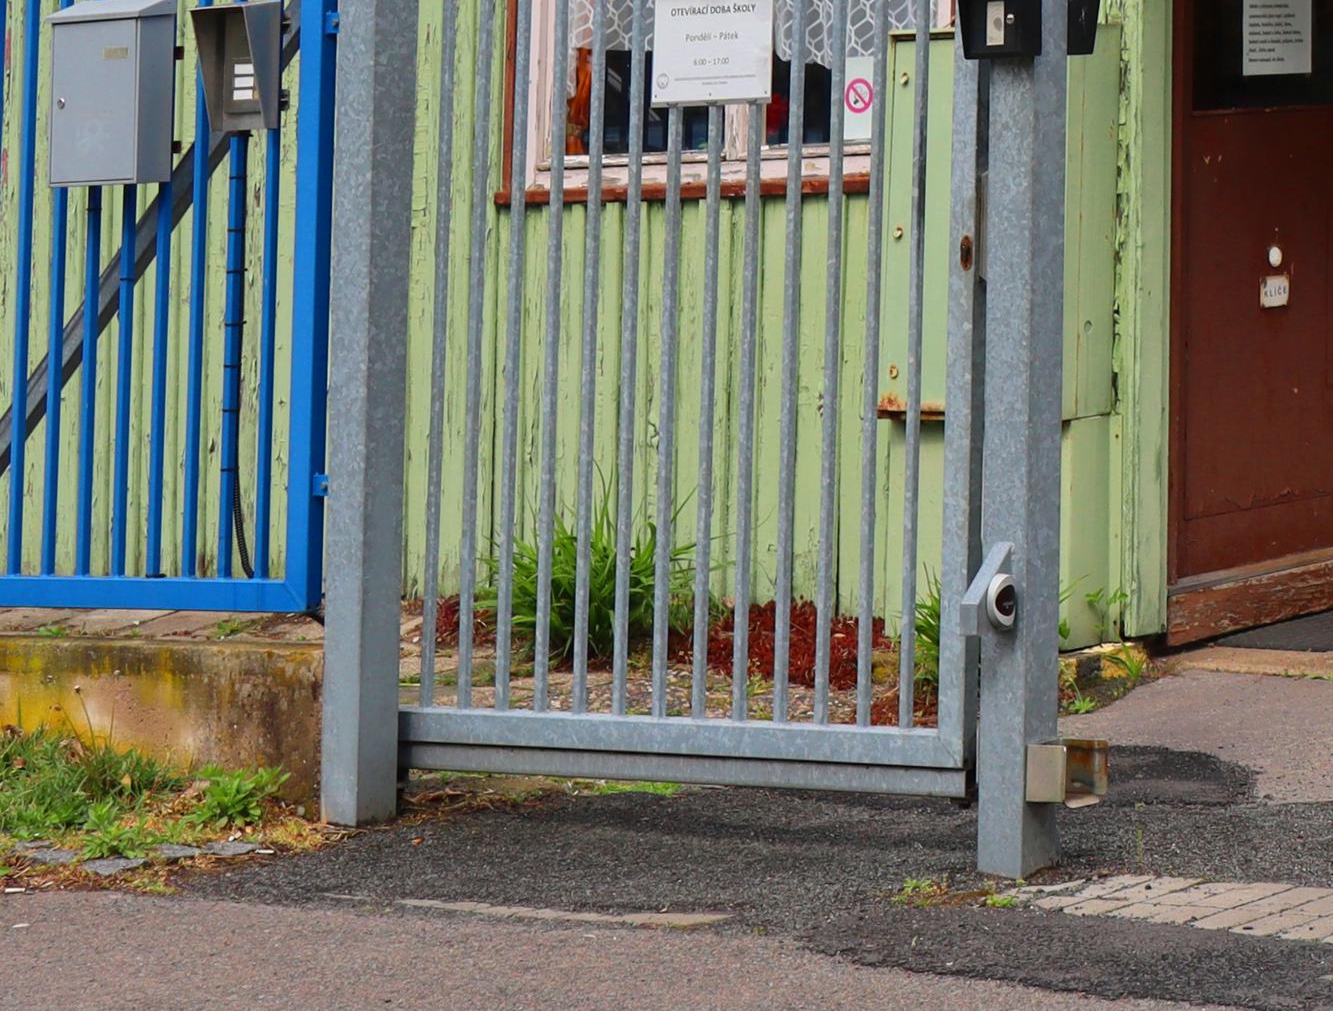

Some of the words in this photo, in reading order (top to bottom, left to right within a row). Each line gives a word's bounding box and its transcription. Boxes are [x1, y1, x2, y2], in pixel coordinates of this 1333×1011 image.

[671, 4, 709, 17] OTEVÍRACÍ
[710, 5, 731, 15] DOBA
[732, 2, 756, 13] ŠKOLY
[685, 32, 711, 43] Pondělí
[719, 31, 738, 41] Pátek
